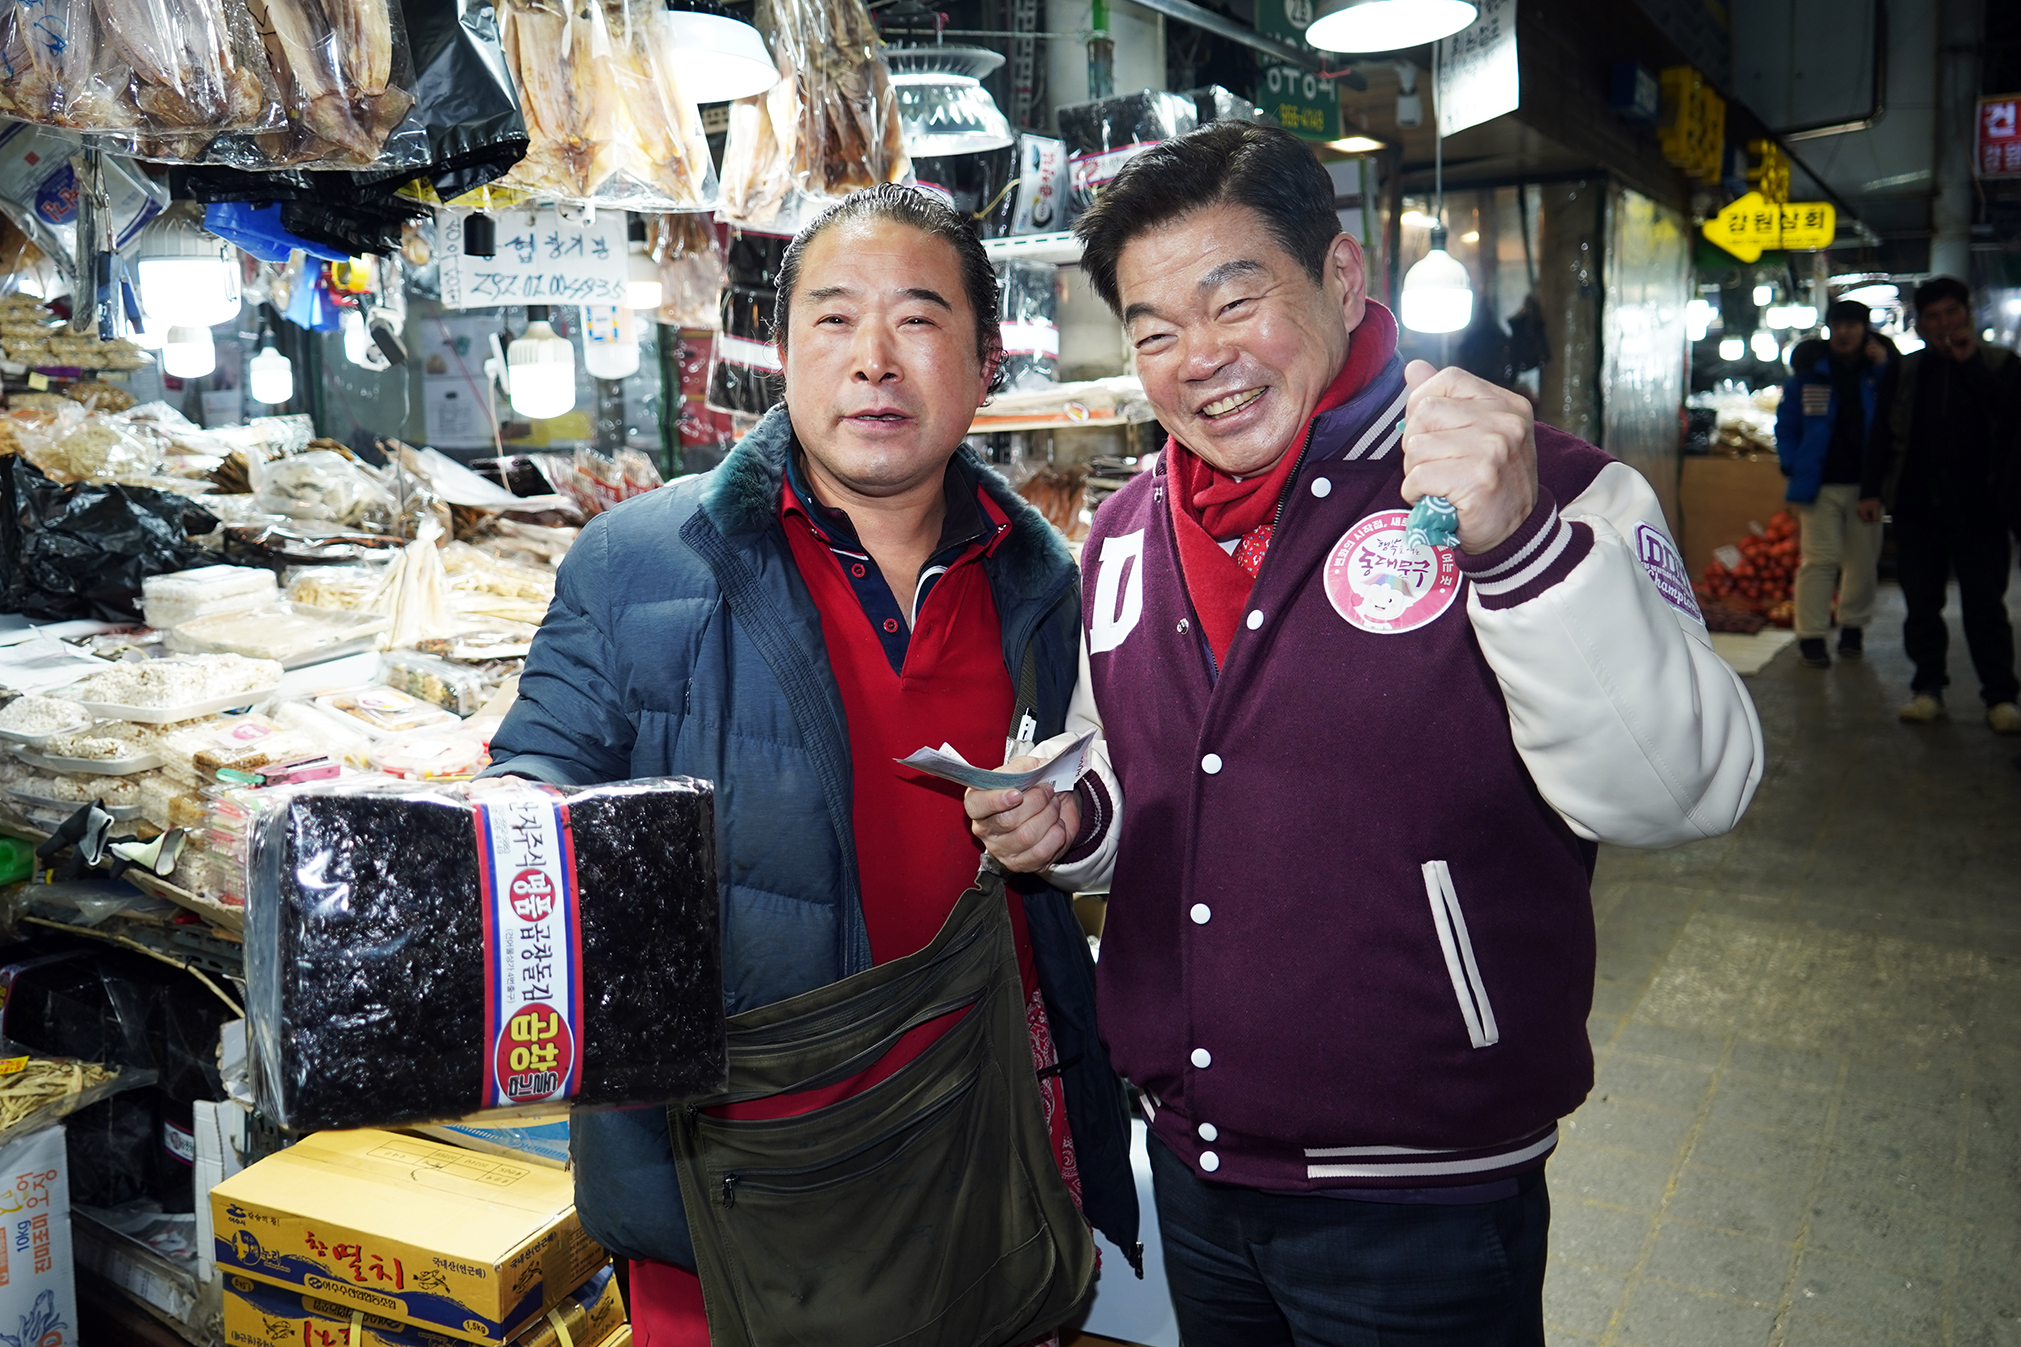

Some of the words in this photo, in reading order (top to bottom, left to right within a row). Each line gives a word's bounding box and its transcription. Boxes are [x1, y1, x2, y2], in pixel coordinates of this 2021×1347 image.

[1090, 527, 1145, 654] D
[1358, 545, 1431, 588] 동대문구
[1440, 575, 1453, 587] 곳
[512, 872, 554, 919] 명품
[520, 923, 554, 1002] 곱창돌김
[509, 1011, 560, 1073] 곱창
[15, 1219, 32, 1253] 10kg
[31, 1212, 52, 1275] 진미조미
